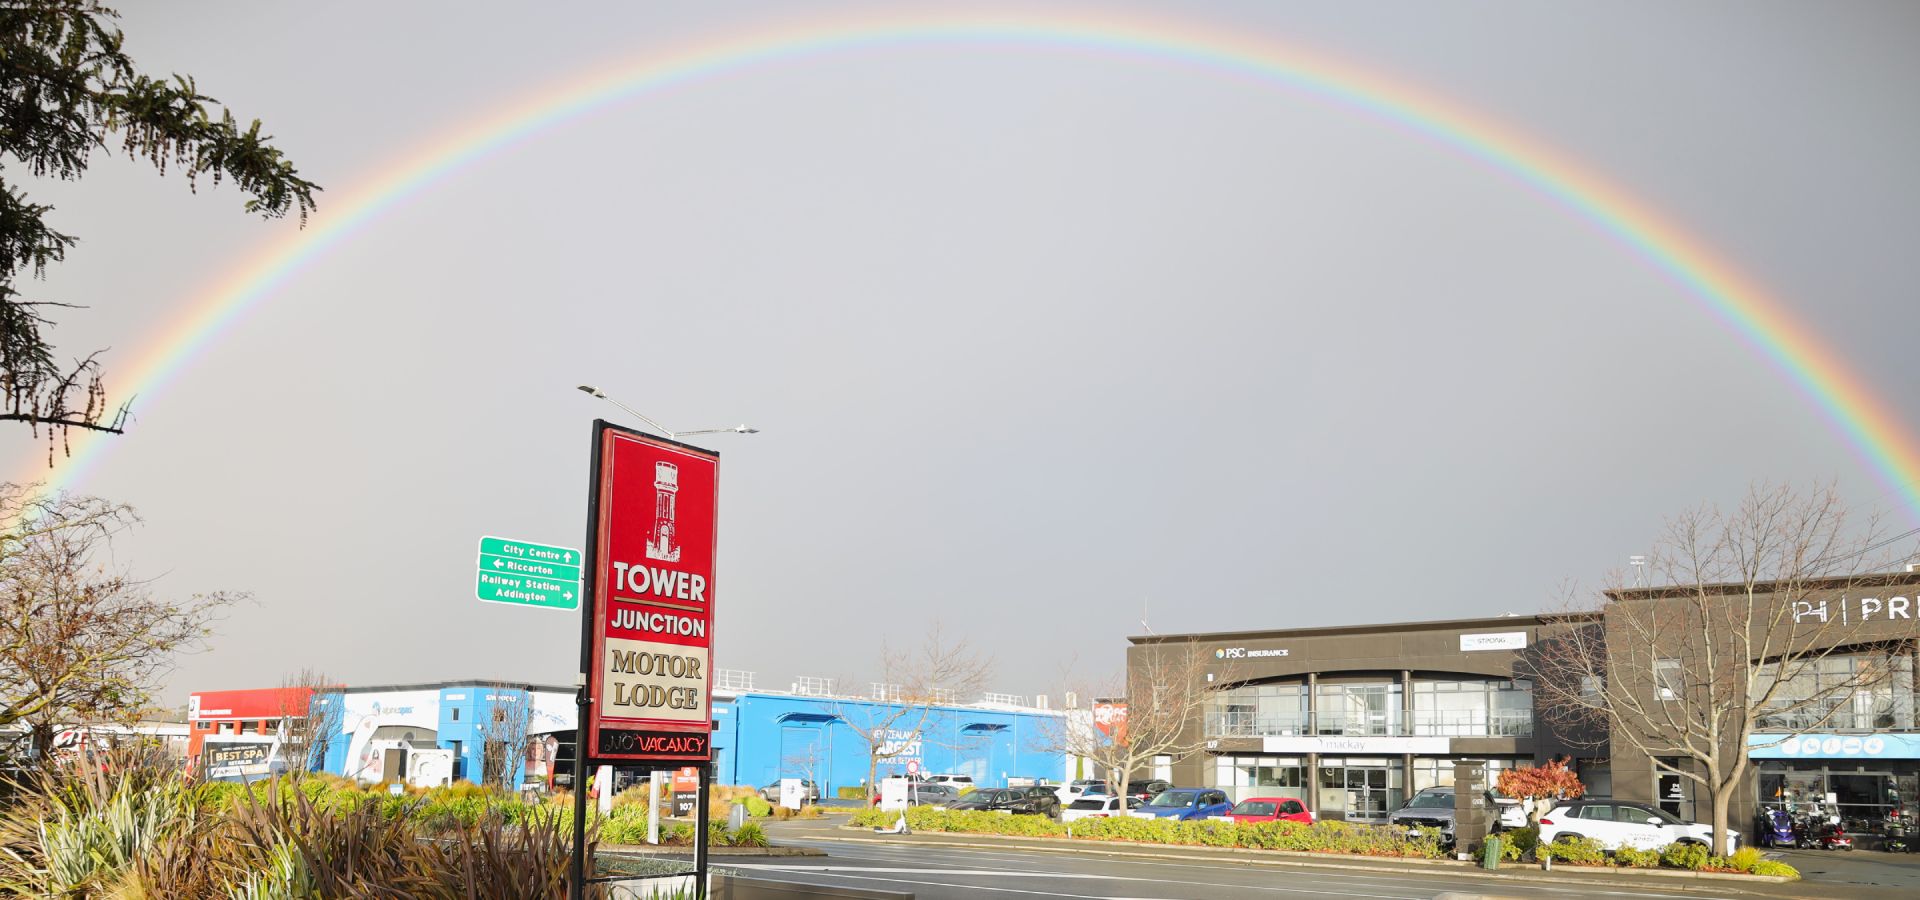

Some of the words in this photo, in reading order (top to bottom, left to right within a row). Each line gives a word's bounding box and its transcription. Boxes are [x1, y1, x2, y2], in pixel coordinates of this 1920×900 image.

[503, 544, 525, 556] City
[529, 548, 560, 560] Centre
[507, 561, 553, 575] Riccarton
[481, 574, 521, 588] Railway
[526, 579, 561, 592] Station
[613, 561, 706, 602] TOWER
[495, 588, 547, 602] Addington
[1861, 596, 1920, 621] PR
[611, 608, 705, 638] JUNCTION
[1225, 647, 1246, 659] PSC
[1247, 649, 1289, 658] INSURANCE
[611, 649, 702, 679] MOTOR
[613, 682, 698, 710] LODGE
[636, 735, 705, 753] VACANCY
[871, 740, 922, 756] ARGEST
[1326, 740, 1366, 751] mackay
[216, 751, 242, 761] BEST
[243, 749, 264, 759] SPA
[679, 802, 694, 811] 107
